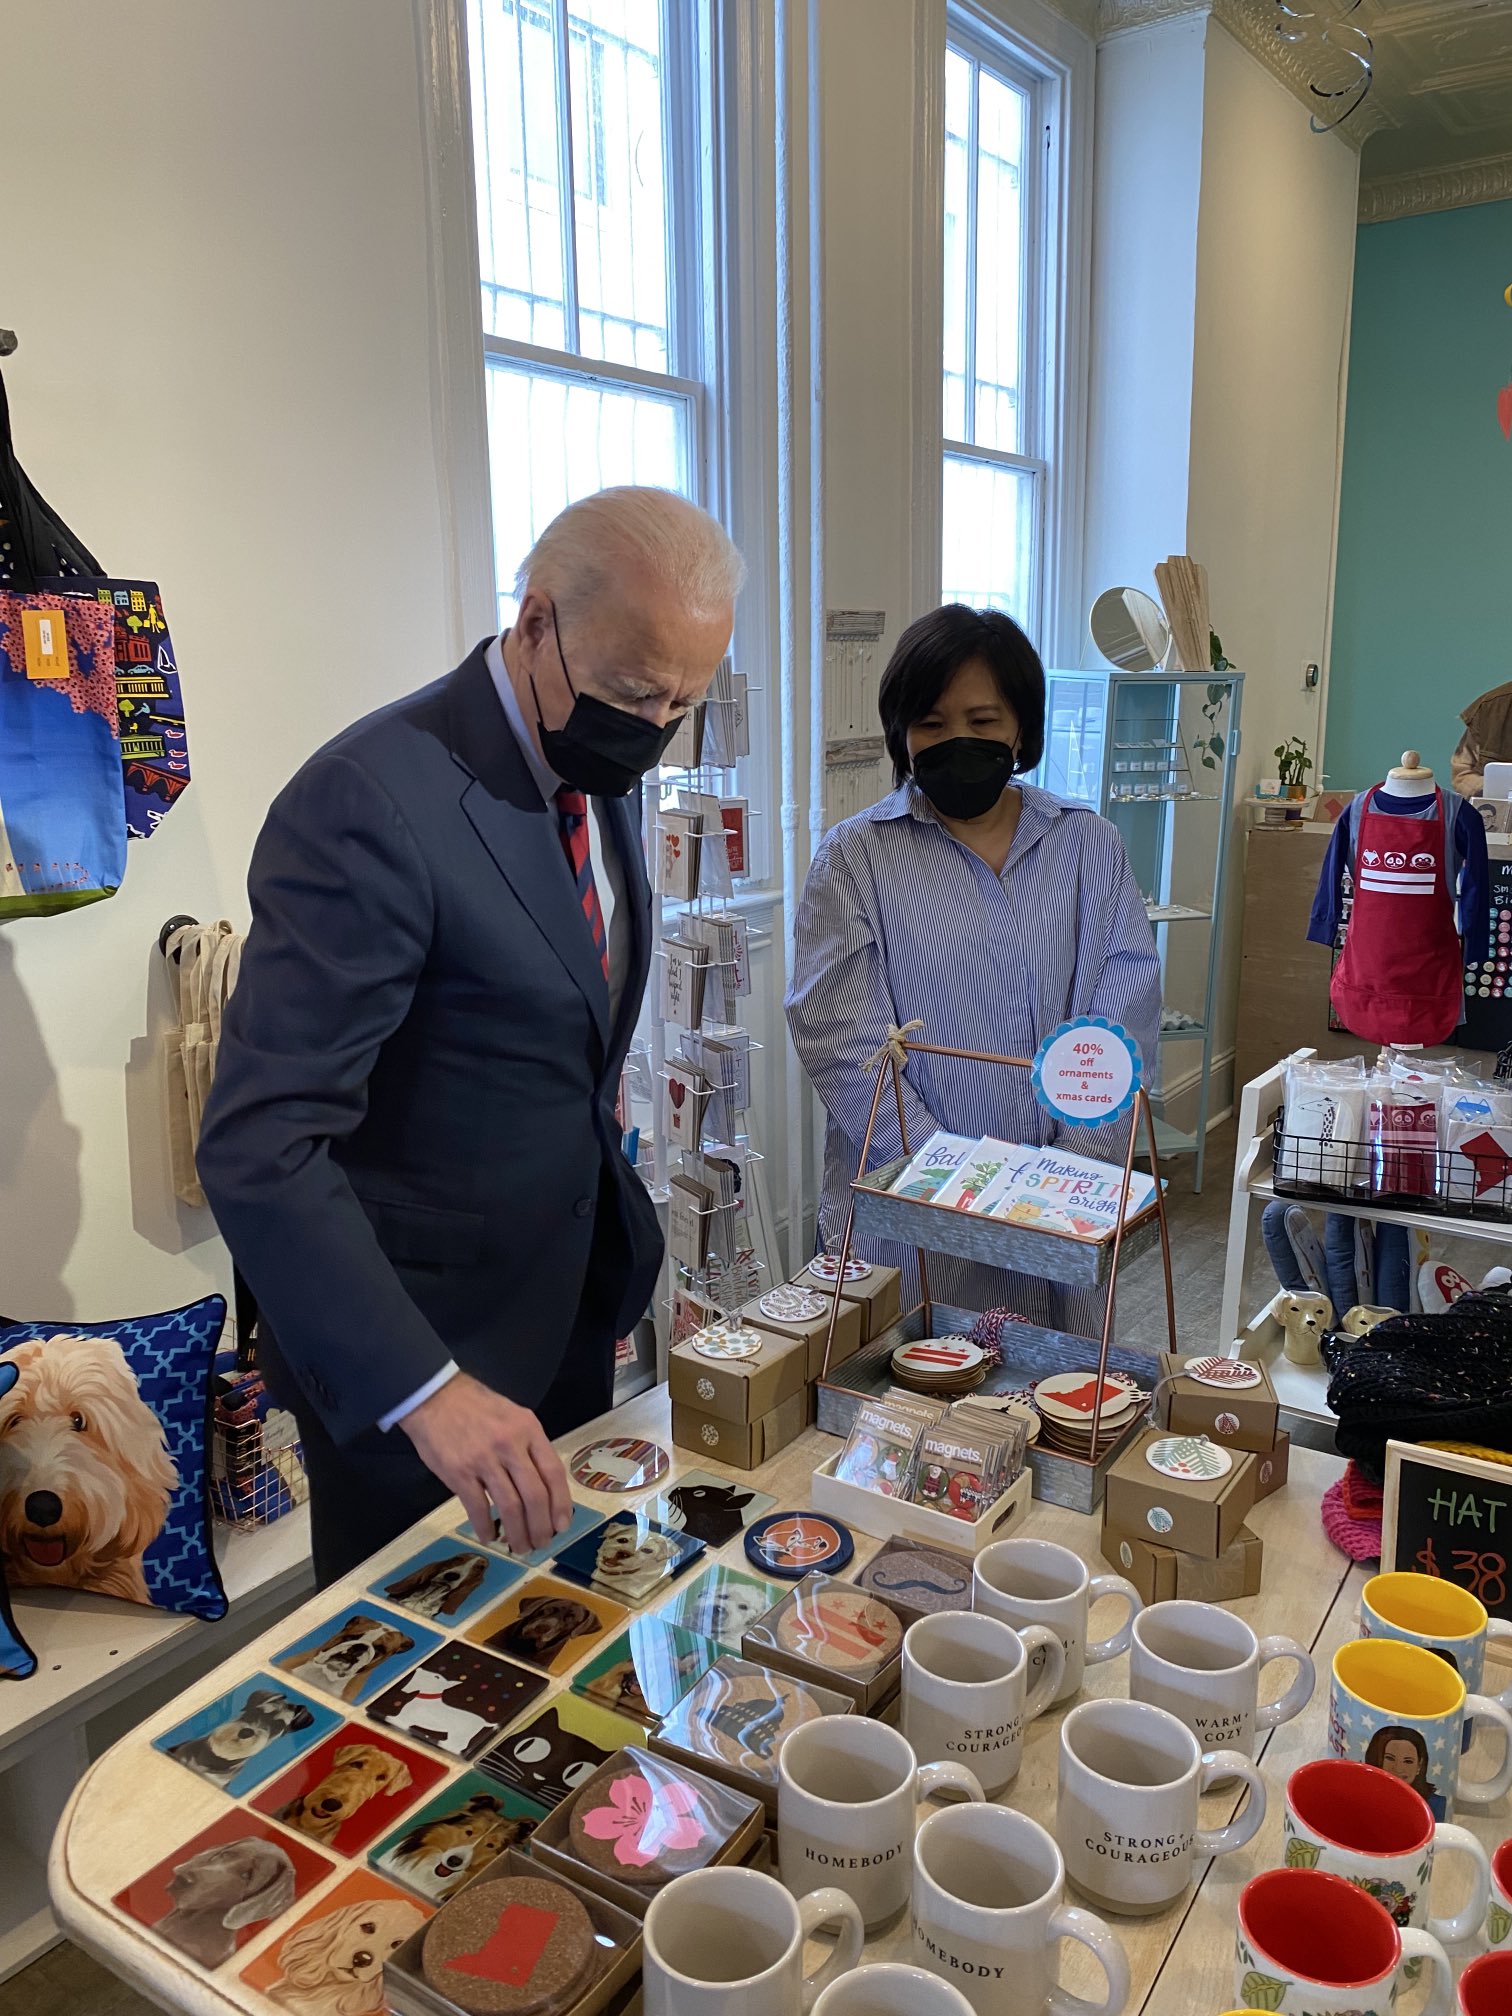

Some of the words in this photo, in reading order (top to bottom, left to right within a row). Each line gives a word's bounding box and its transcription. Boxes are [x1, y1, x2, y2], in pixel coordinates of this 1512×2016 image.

[1073, 1043, 1104, 1056] 40%
[1080, 1057, 1095, 1067] off
[1058, 1069, 1114, 1080] ornaments
[1080, 1081, 1089, 1090] &
[1056, 1092, 1083, 1102] xmas
[1084, 1094, 1113, 1104] cards
[1036, 1157, 1104, 1181] Making
[1068, 1194, 1119, 1214] Brigh
[1427, 1488, 1507, 1534] HAT
[946, 1726, 1023, 1753] COURAGEO
[1204, 1727, 1243, 1743] COZY
[805, 1841, 904, 1869] HOMEBODY
[1085, 1834, 1195, 1864] COURAGEOUS
